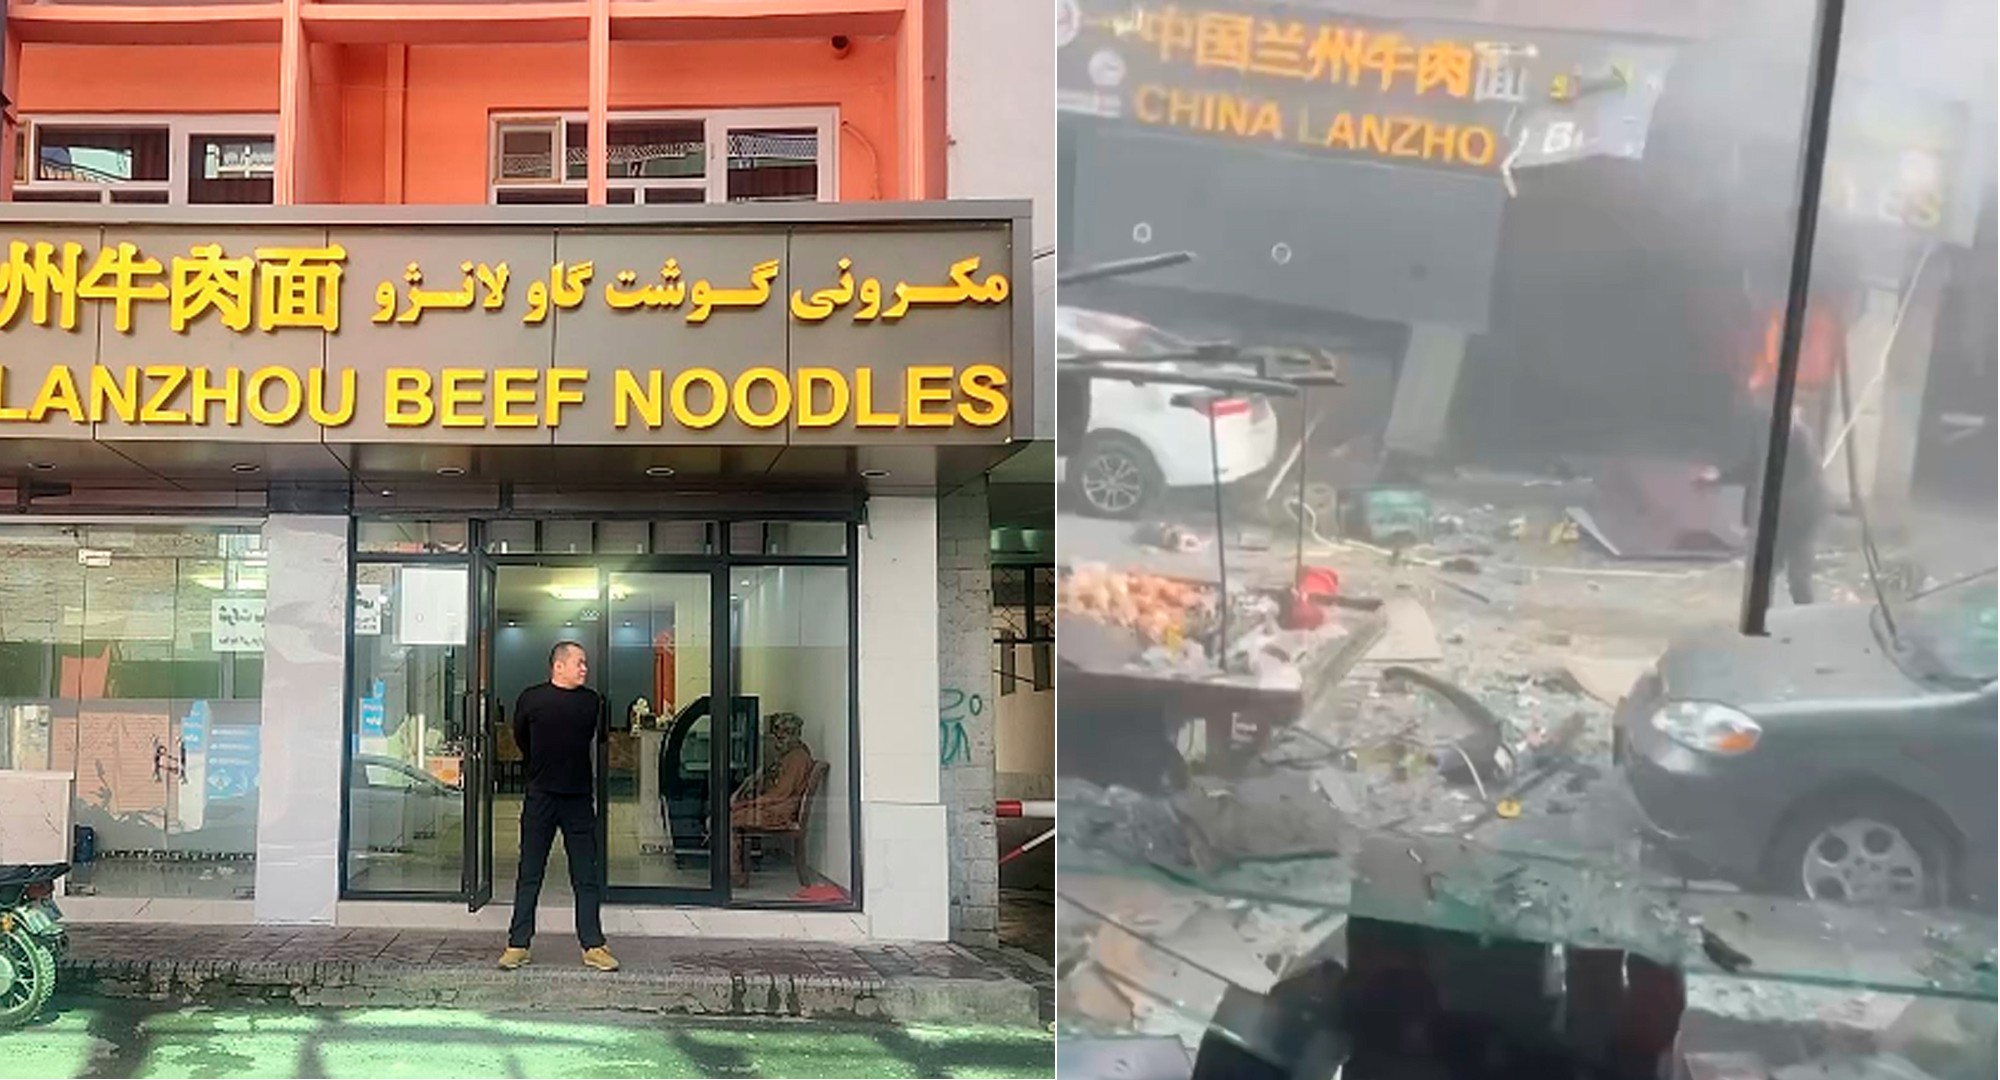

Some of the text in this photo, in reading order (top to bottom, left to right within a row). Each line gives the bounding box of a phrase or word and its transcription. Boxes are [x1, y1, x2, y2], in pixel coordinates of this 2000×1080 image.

[1139, 7, 1538, 103] 中国兰州牛肉面
[1136, 83, 1284, 139] CHINA
[0, 240, 346, 333] 州牛肉面
[371, 256, 1010, 323] مکرونی گوشت گاو لانژو
[0, 363, 1010, 429] LANZHOU BEEF NOODLES
